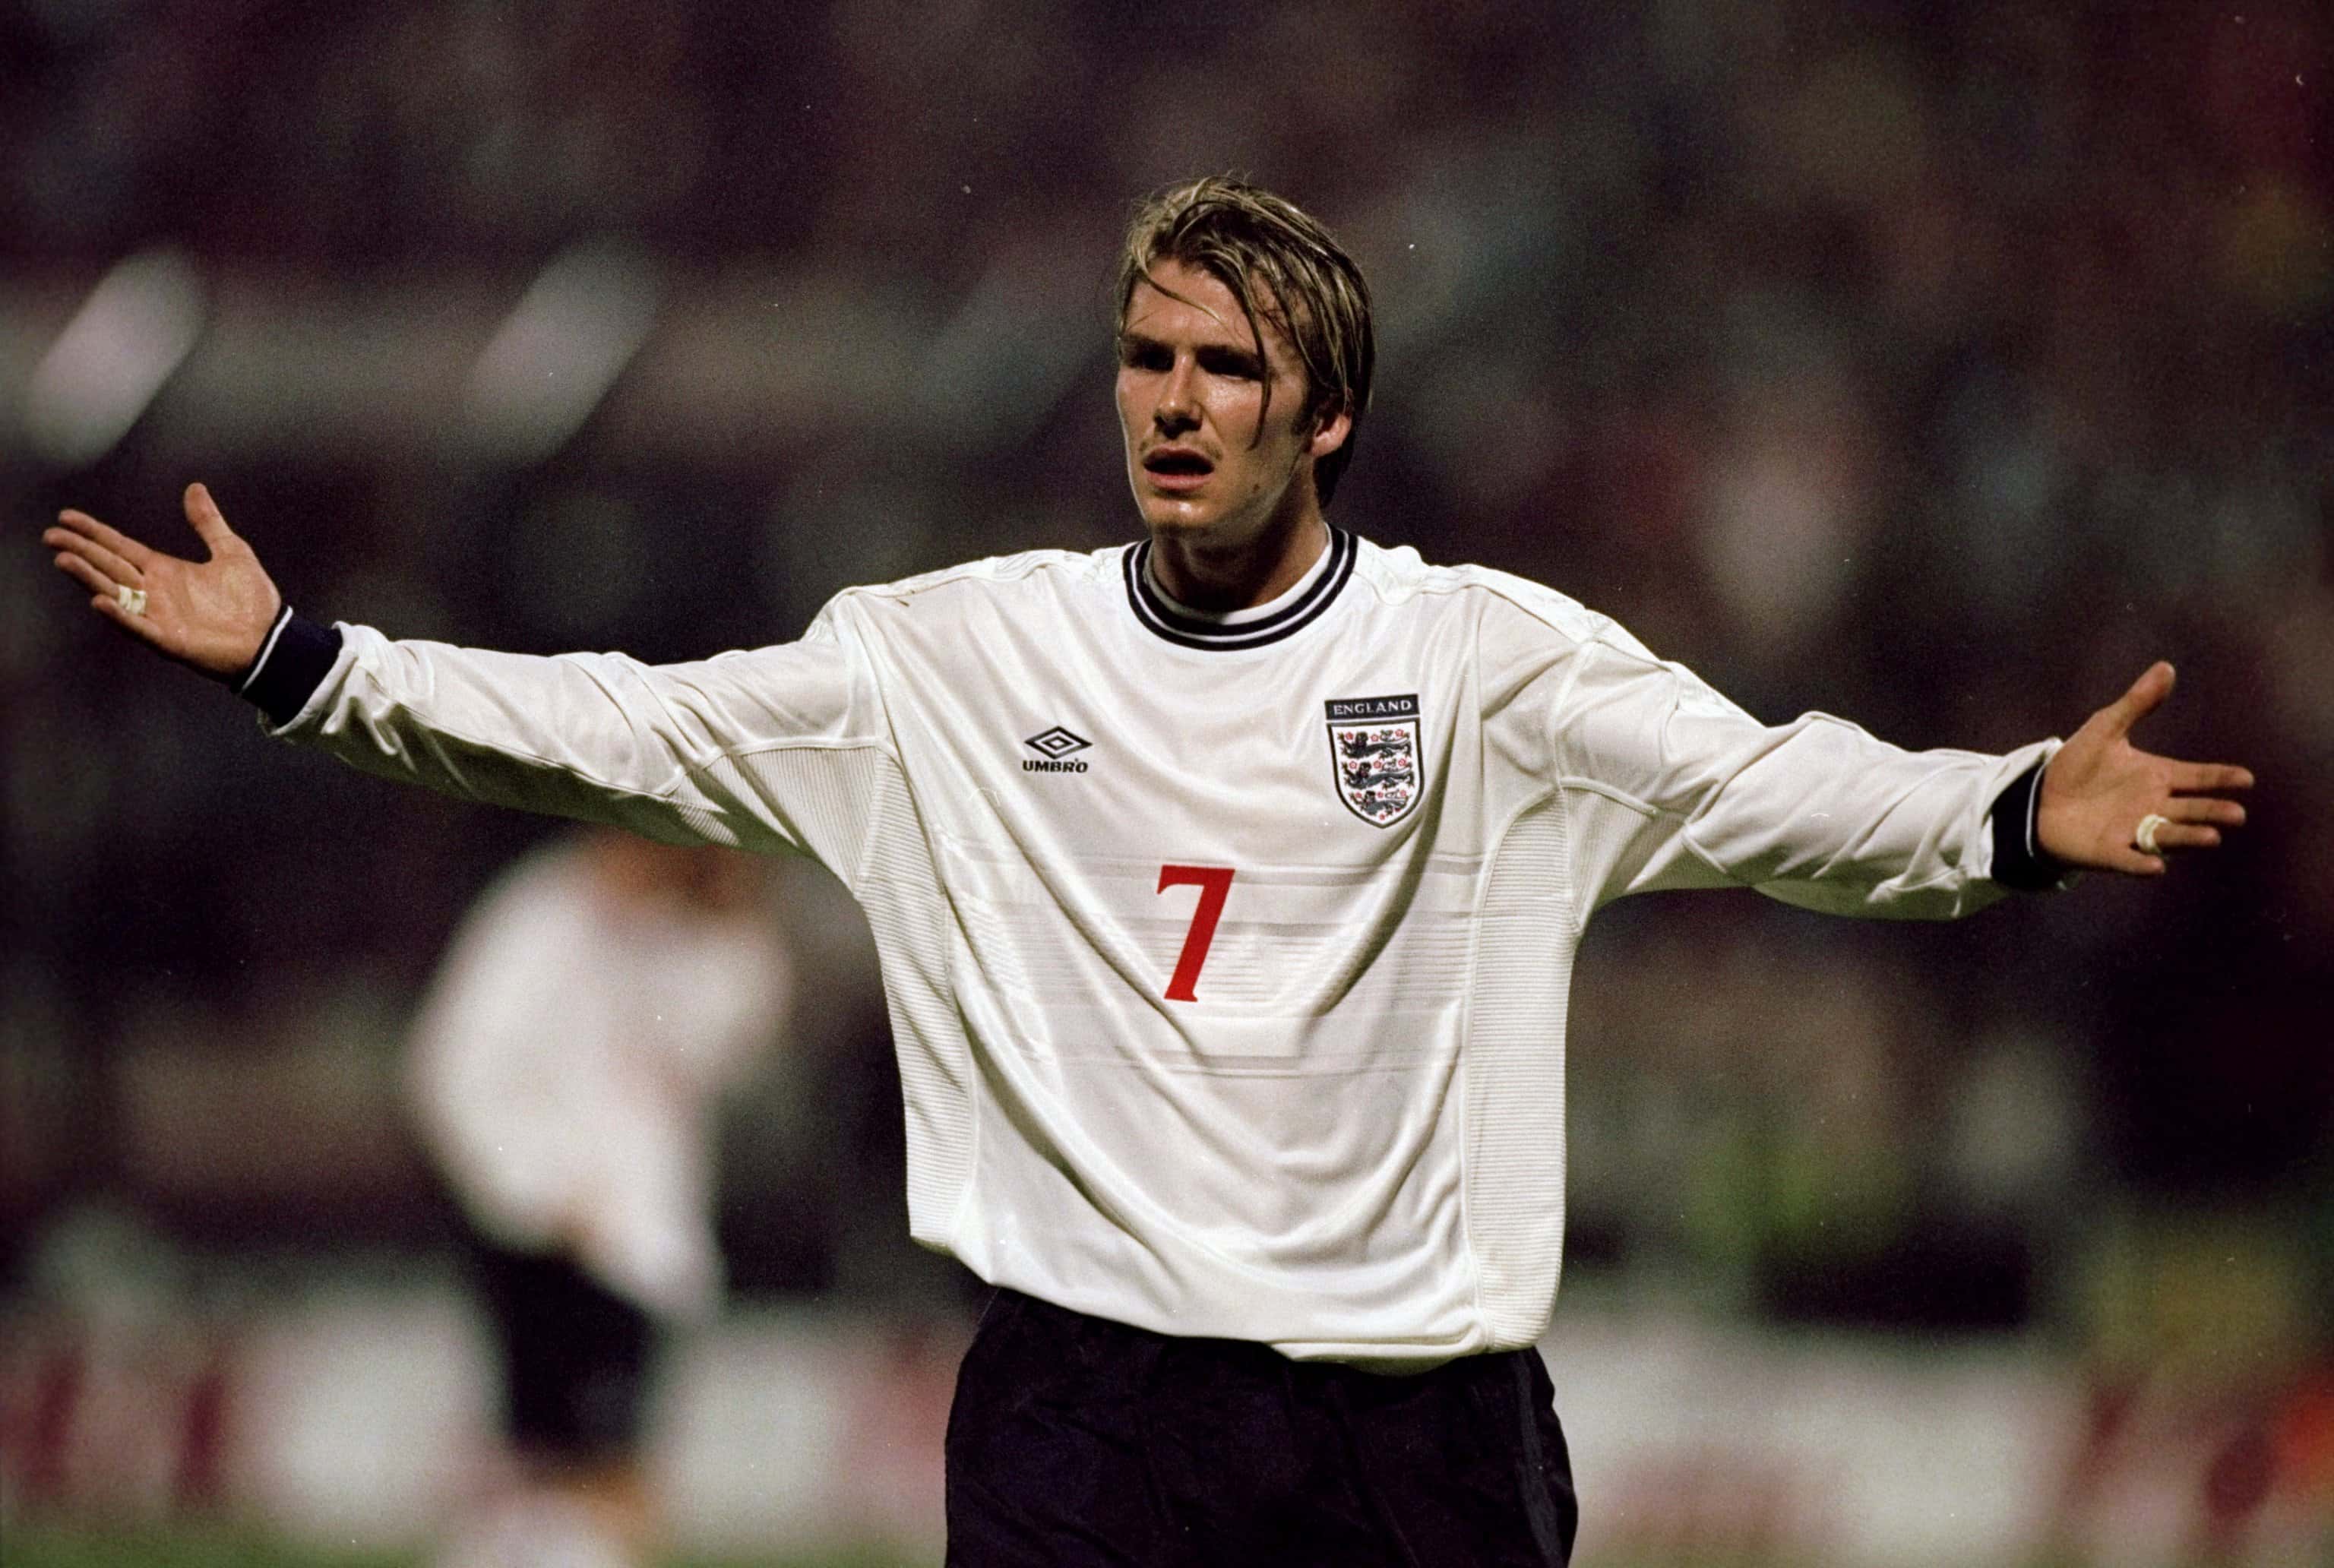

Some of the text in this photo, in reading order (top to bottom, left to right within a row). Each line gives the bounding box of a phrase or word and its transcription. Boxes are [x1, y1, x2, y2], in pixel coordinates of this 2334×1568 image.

[1333, 700, 1412, 716] ENGLAND
[1022, 760, 1088, 773] UMBRO
[1156, 865, 1235, 1003] 7
